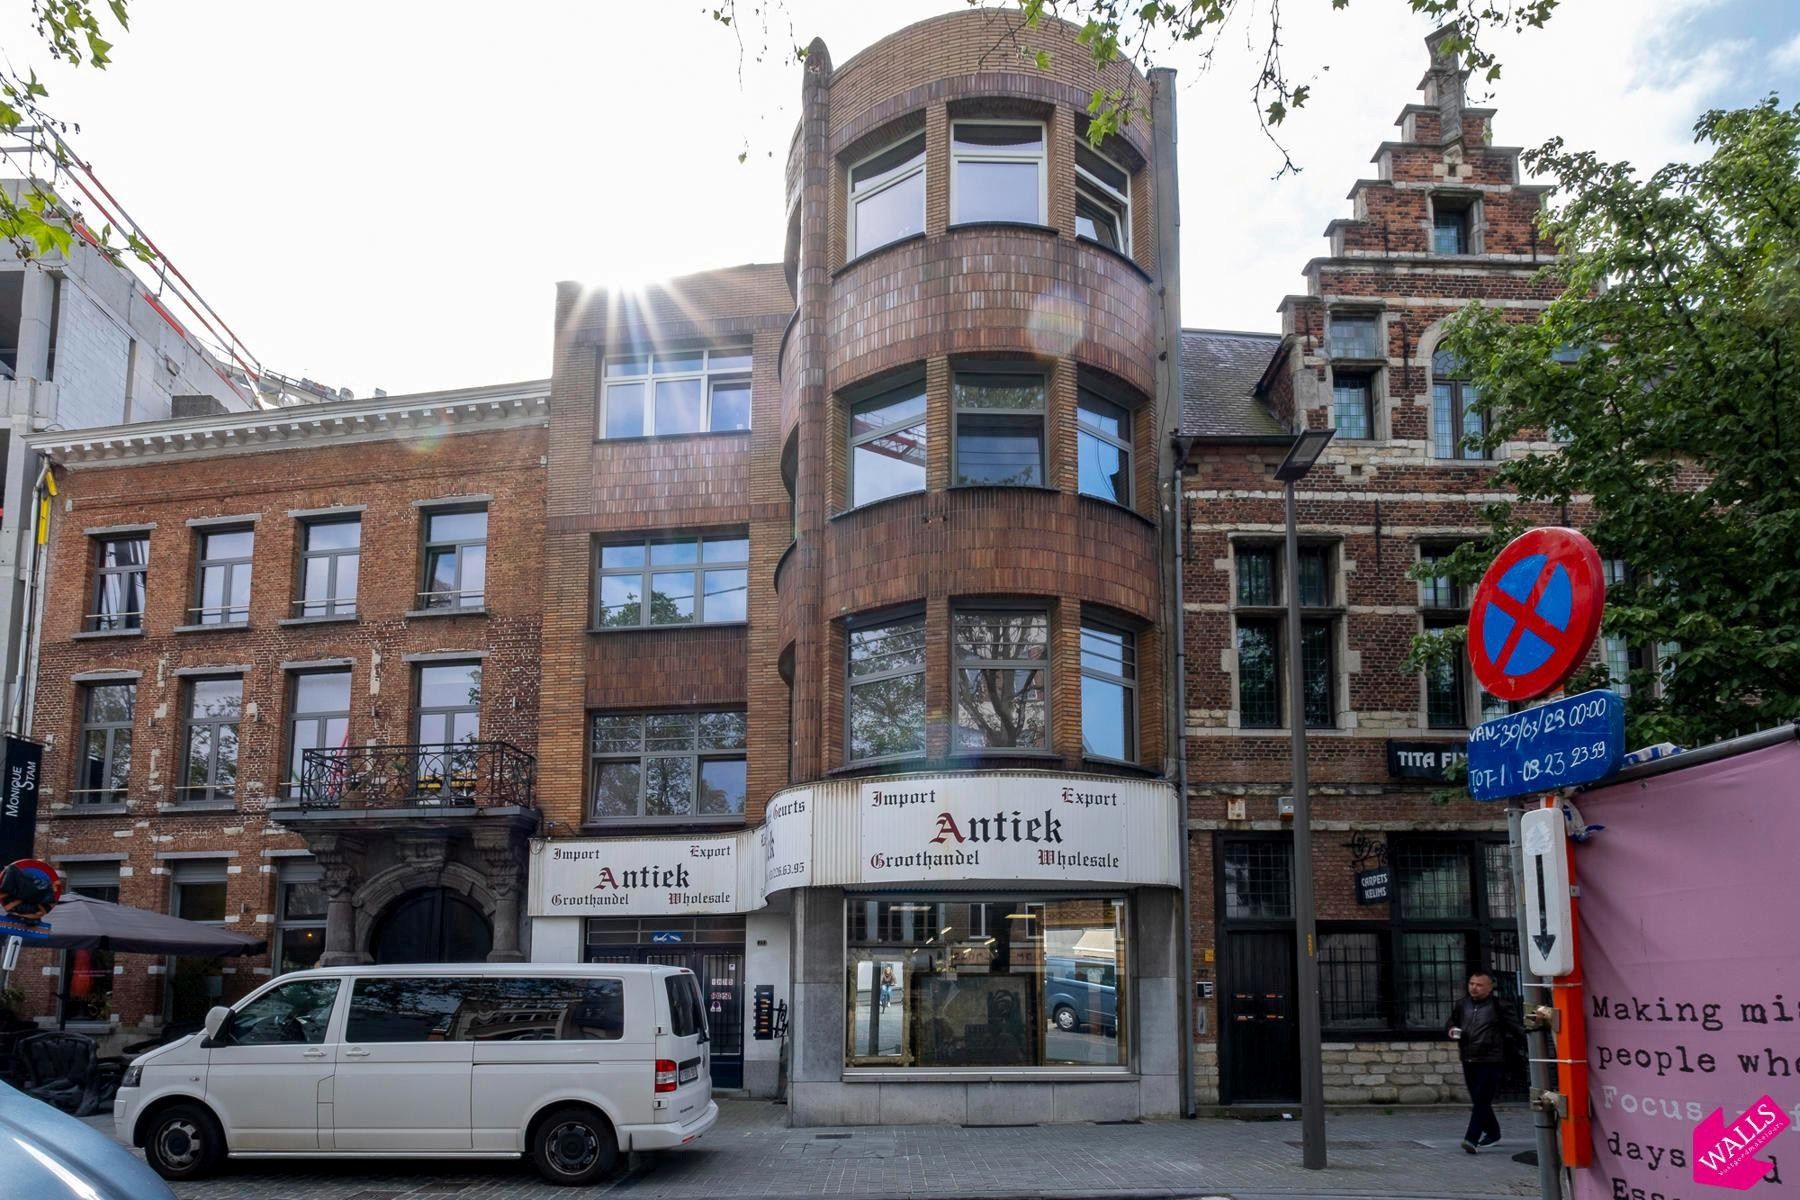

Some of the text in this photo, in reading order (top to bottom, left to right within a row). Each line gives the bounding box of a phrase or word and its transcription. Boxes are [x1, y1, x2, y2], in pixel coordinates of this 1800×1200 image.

[1569, 698, 1606, 727] 00:00
[1397, 751, 1435, 768] TITA
[872, 787, 1117, 808] Import Export
[929, 808, 1063, 844] Antiek
[553, 845, 730, 862] Import Export
[871, 849, 1119, 870] Groothandel Wholesale
[593, 863, 690, 890] Antiek
[1361, 873, 1388, 887] CARPETS
[552, 892, 730, 908] Groothandel Wholesale
[1592, 995, 1800, 1031] Making mi
[1596, 1045, 1717, 1076] people
[1602, 1085, 1703, 1121] Focus
[1607, 1131, 1686, 1171] days
